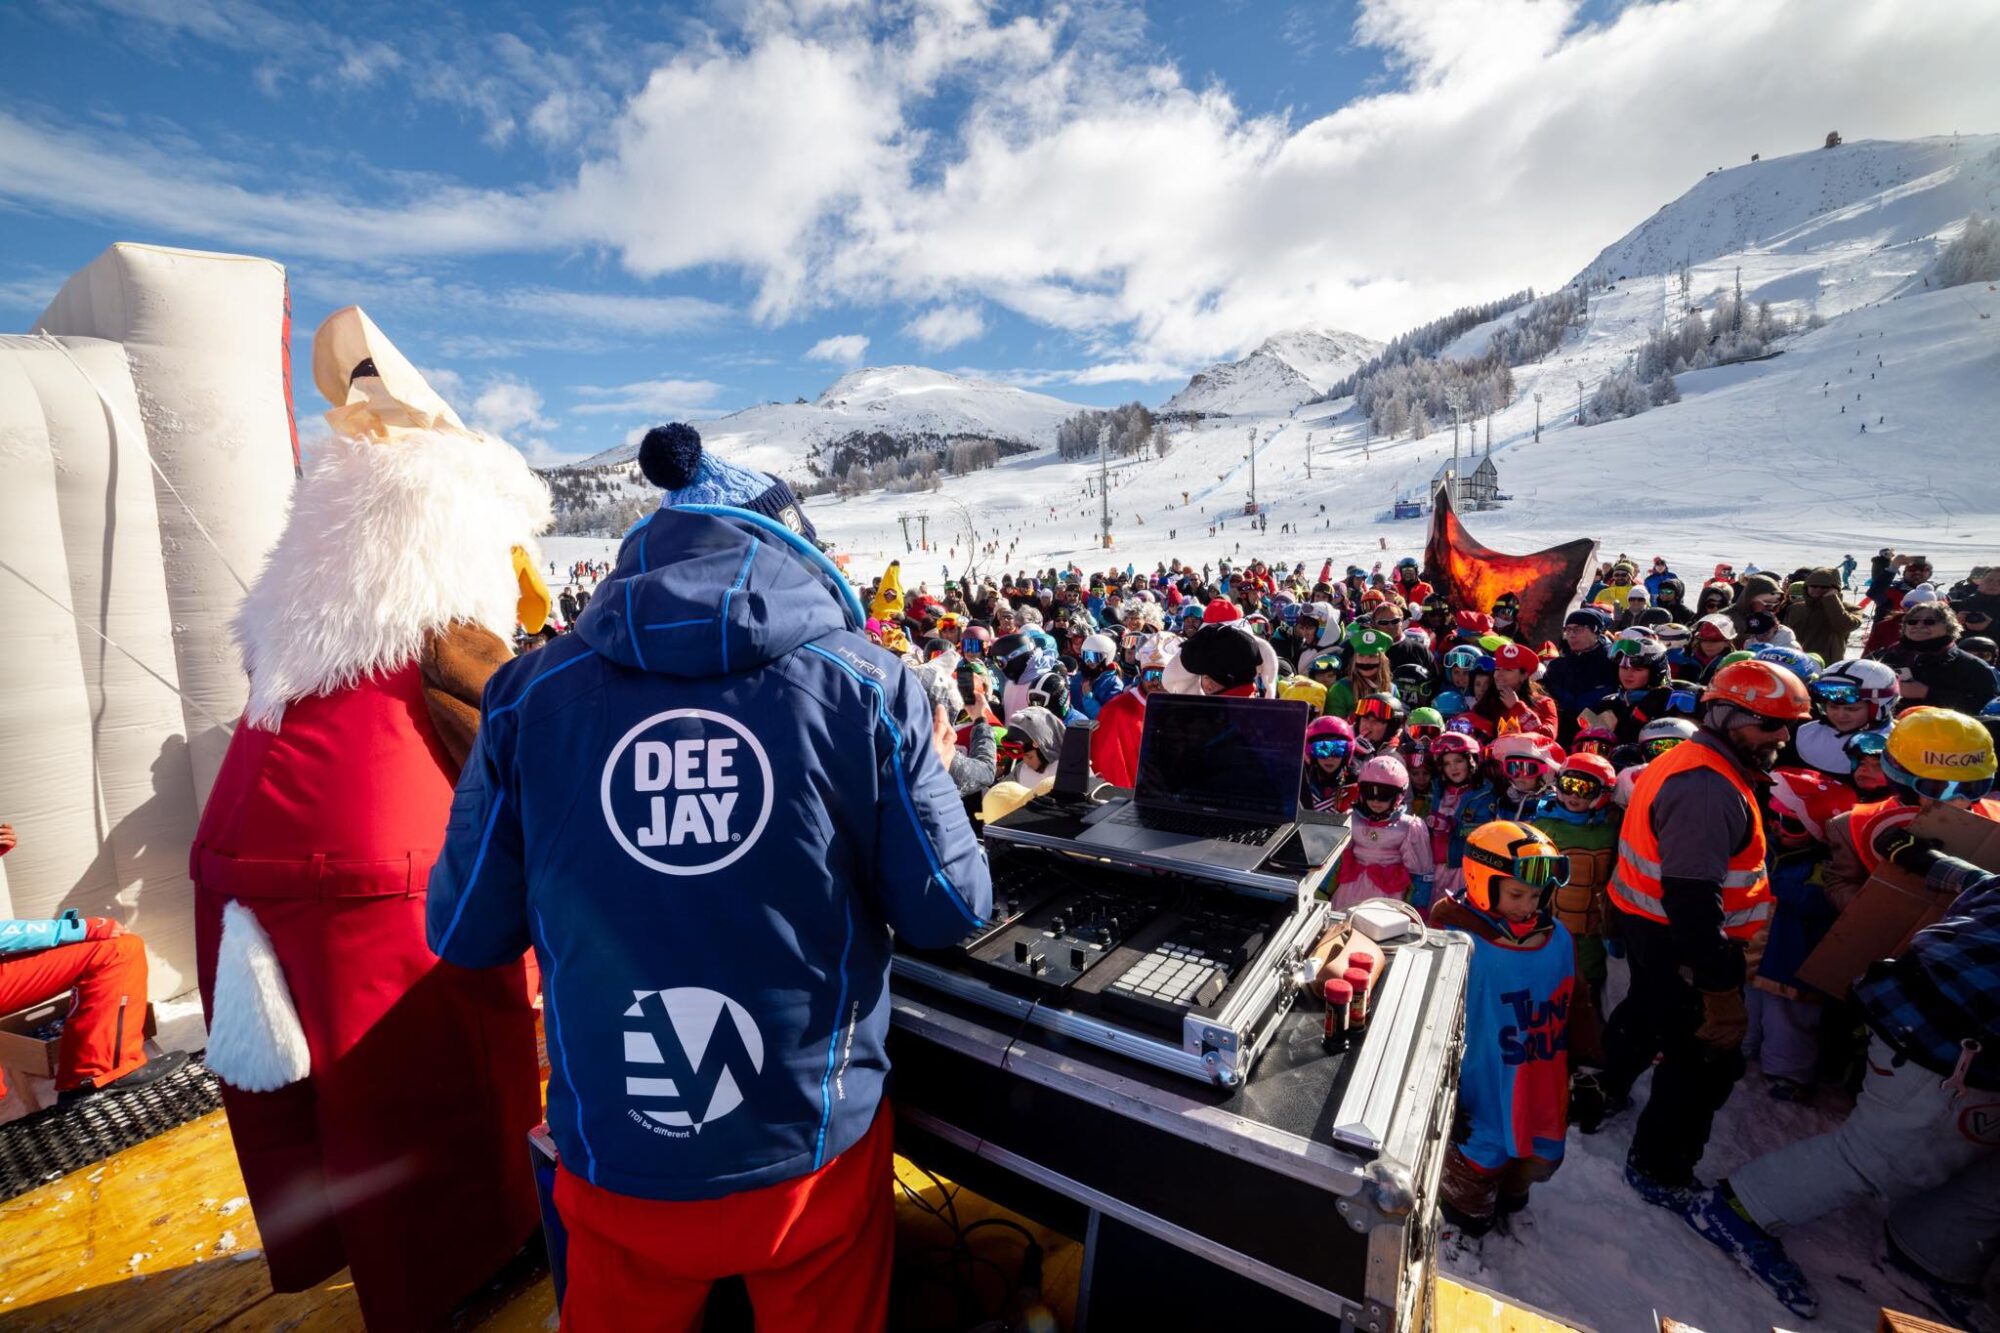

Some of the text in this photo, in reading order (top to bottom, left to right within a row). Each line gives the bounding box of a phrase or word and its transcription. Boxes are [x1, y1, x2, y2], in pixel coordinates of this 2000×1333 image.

[838, 647, 886, 680] HYRA
[634, 738, 739, 792] DEE
[642, 1120, 653, 1130] be
[653, 1126, 691, 1138] different
